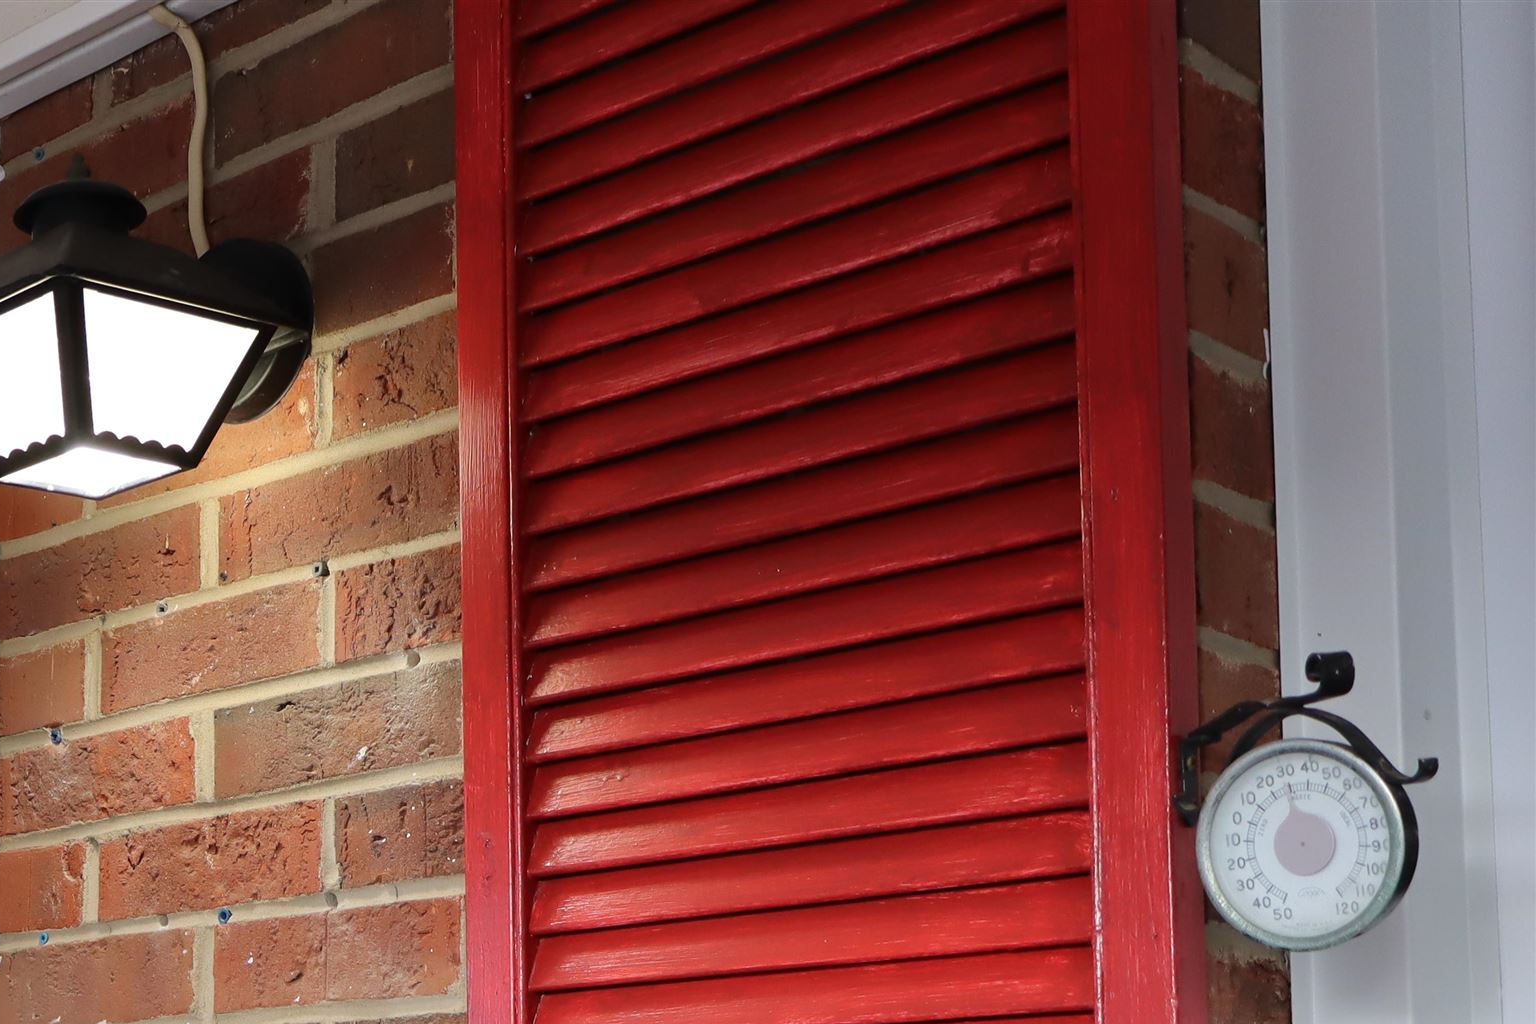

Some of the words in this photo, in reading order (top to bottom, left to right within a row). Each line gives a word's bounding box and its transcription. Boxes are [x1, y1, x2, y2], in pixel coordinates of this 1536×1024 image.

[1275, 763, 1295, 779] 30
[1300, 759, 1320, 774] 40
[1321, 766, 1342, 780] 50
[1255, 774, 1275, 789] 20
[1342, 775, 1363, 791] 60
[1240, 790, 1257, 806] 10
[1358, 794, 1379, 809] 70
[1232, 810, 1243, 826] 0
[1225, 832, 1241, 848] 10
[1226, 856, 1246, 871] 20
[1236, 877, 1255, 892] 30
[1355, 883, 1375, 898] 110
[1252, 895, 1272, 909] 40
[1335, 900, 1359, 915] 120
[1272, 907, 1293, 921] 50
